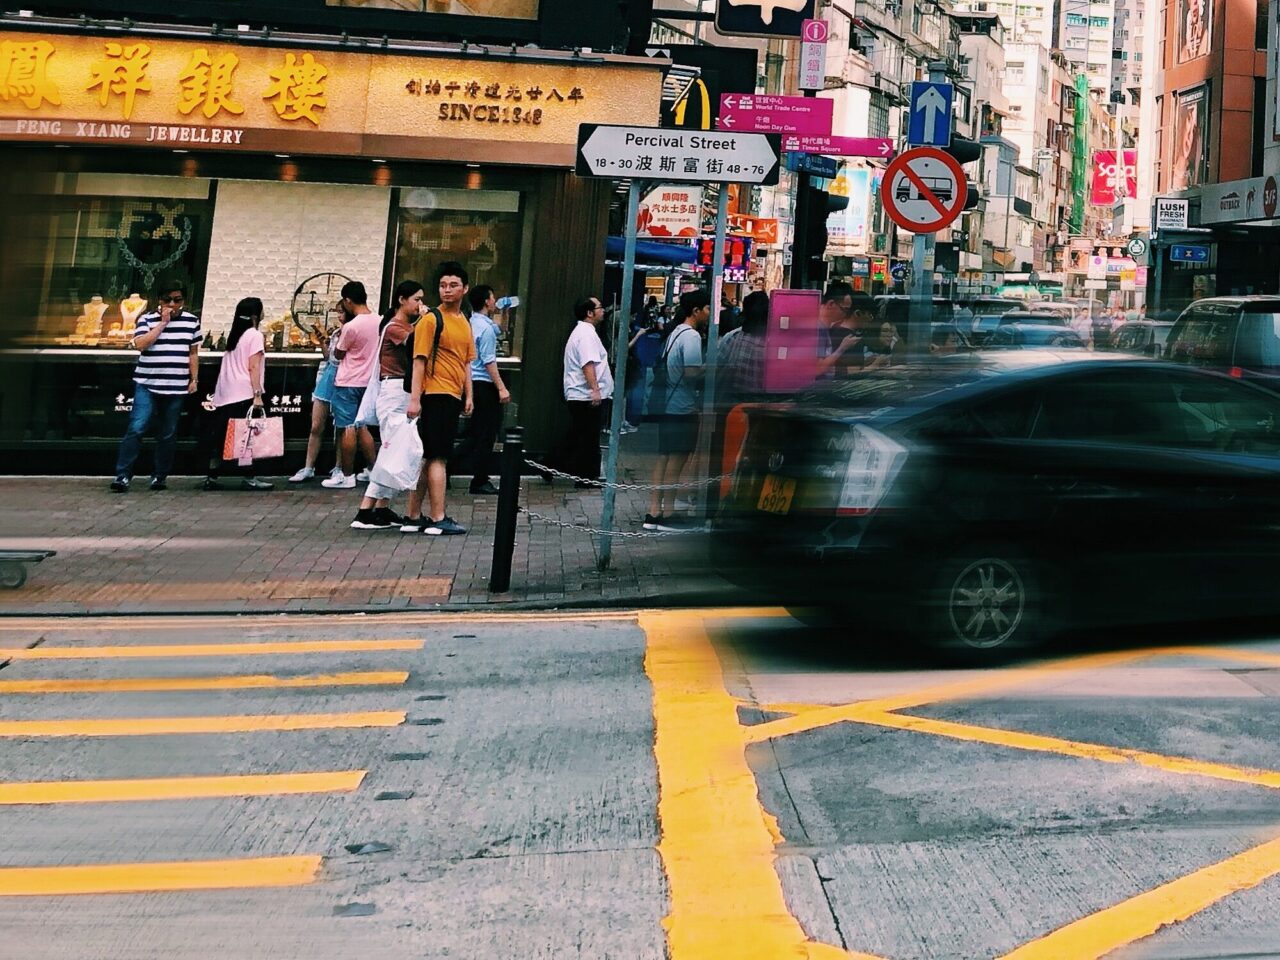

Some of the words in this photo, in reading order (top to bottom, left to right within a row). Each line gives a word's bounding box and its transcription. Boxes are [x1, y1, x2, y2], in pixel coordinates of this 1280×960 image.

[0, 40, 329, 126] 鳳祥銀樓
[15, 119, 62, 136] FENG
[76, 122, 132, 139] XIANG
[146, 125, 244, 145] JEWELLERY
[625, 132, 684, 149] Percival
[690, 136, 737, 151] Street
[820, 145, 841, 153] Square
[595, 158, 607, 168] 18
[618, 158, 633, 168] 30
[635, 154, 724, 175] 波斯富街
[726, 164, 740, 173] 48
[752, 165, 764, 174] 76
[1220, 200, 1240, 210] OUTBACK
[1264, 190, 1276, 206] 3/F
[1160, 203, 1185, 211] LUSH
[1160, 211, 1185, 219] FRESH
